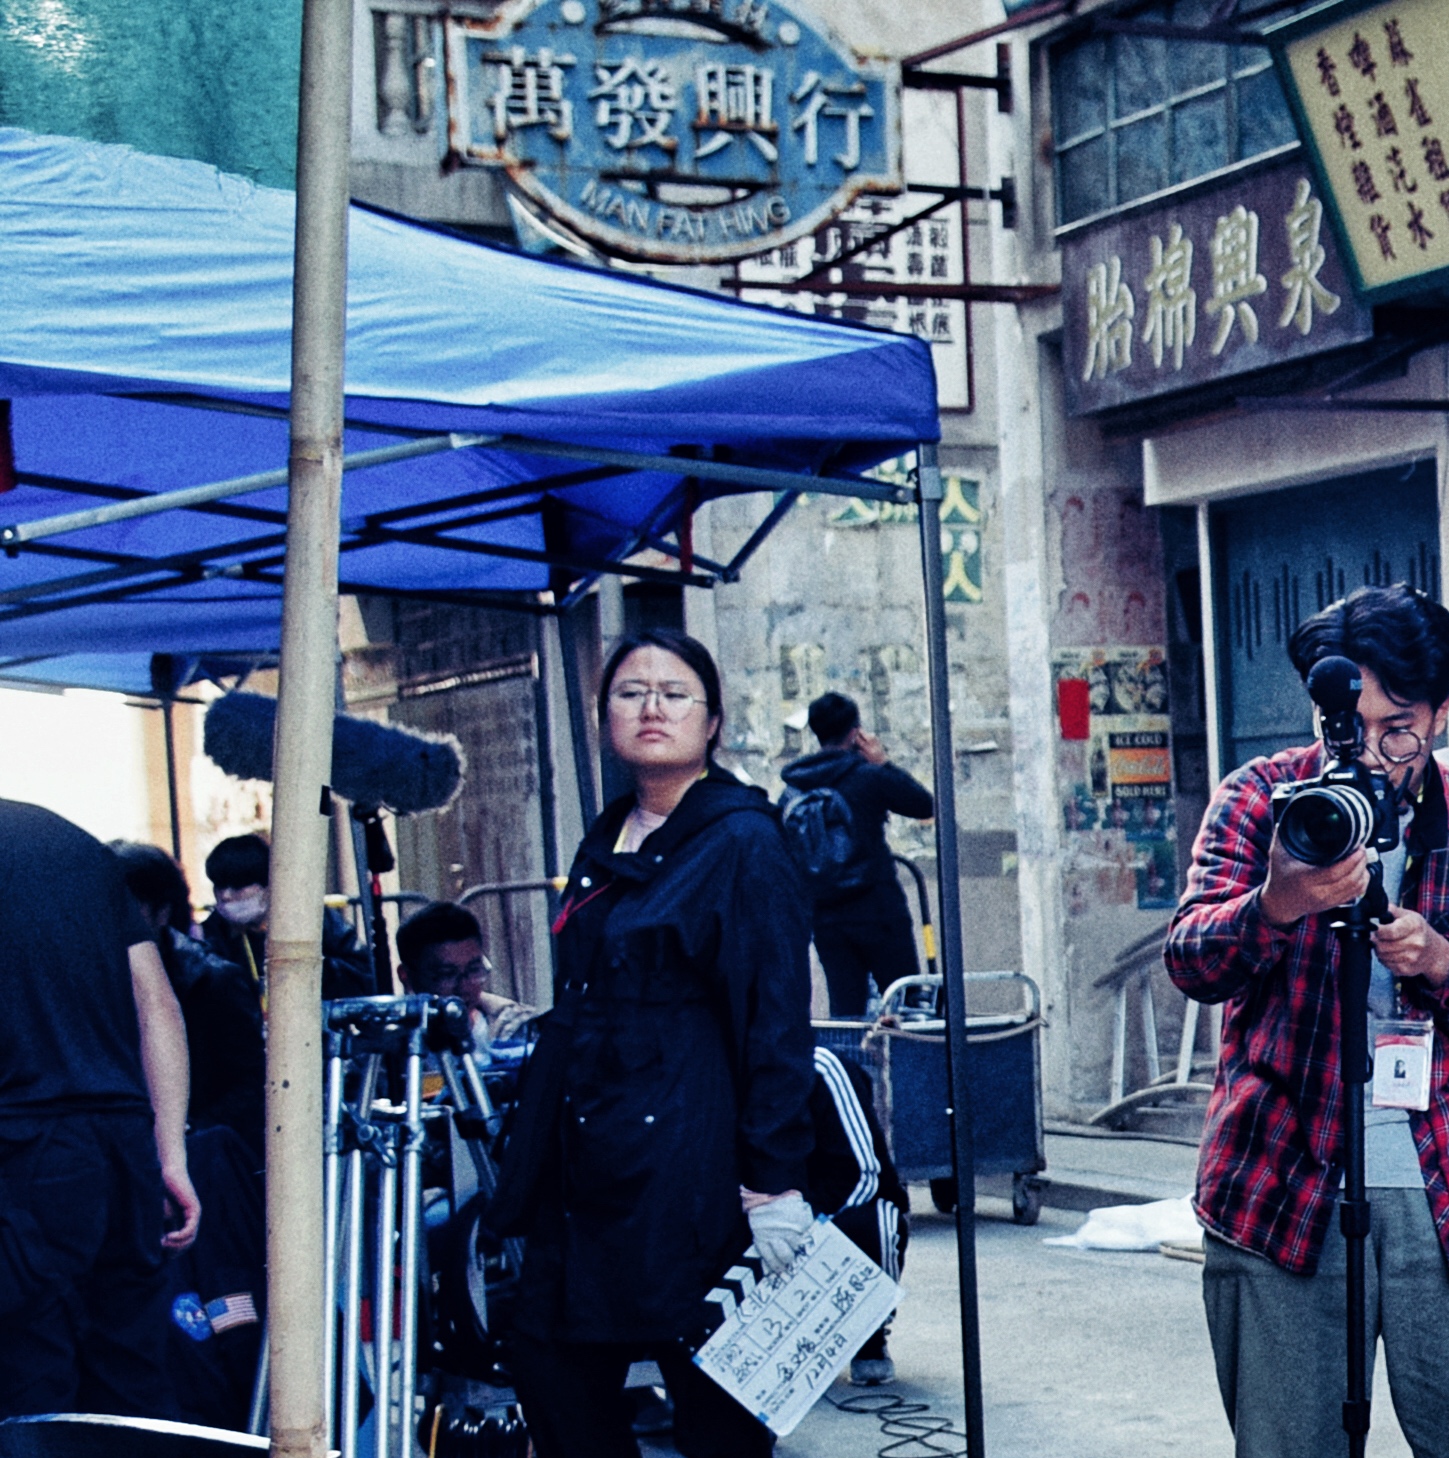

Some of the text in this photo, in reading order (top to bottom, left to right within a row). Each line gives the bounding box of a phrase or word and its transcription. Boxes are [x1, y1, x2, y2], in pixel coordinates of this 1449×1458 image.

[481, 45, 874, 171] 萬發興行
[580, 179, 791, 241] MAN FAT HING
